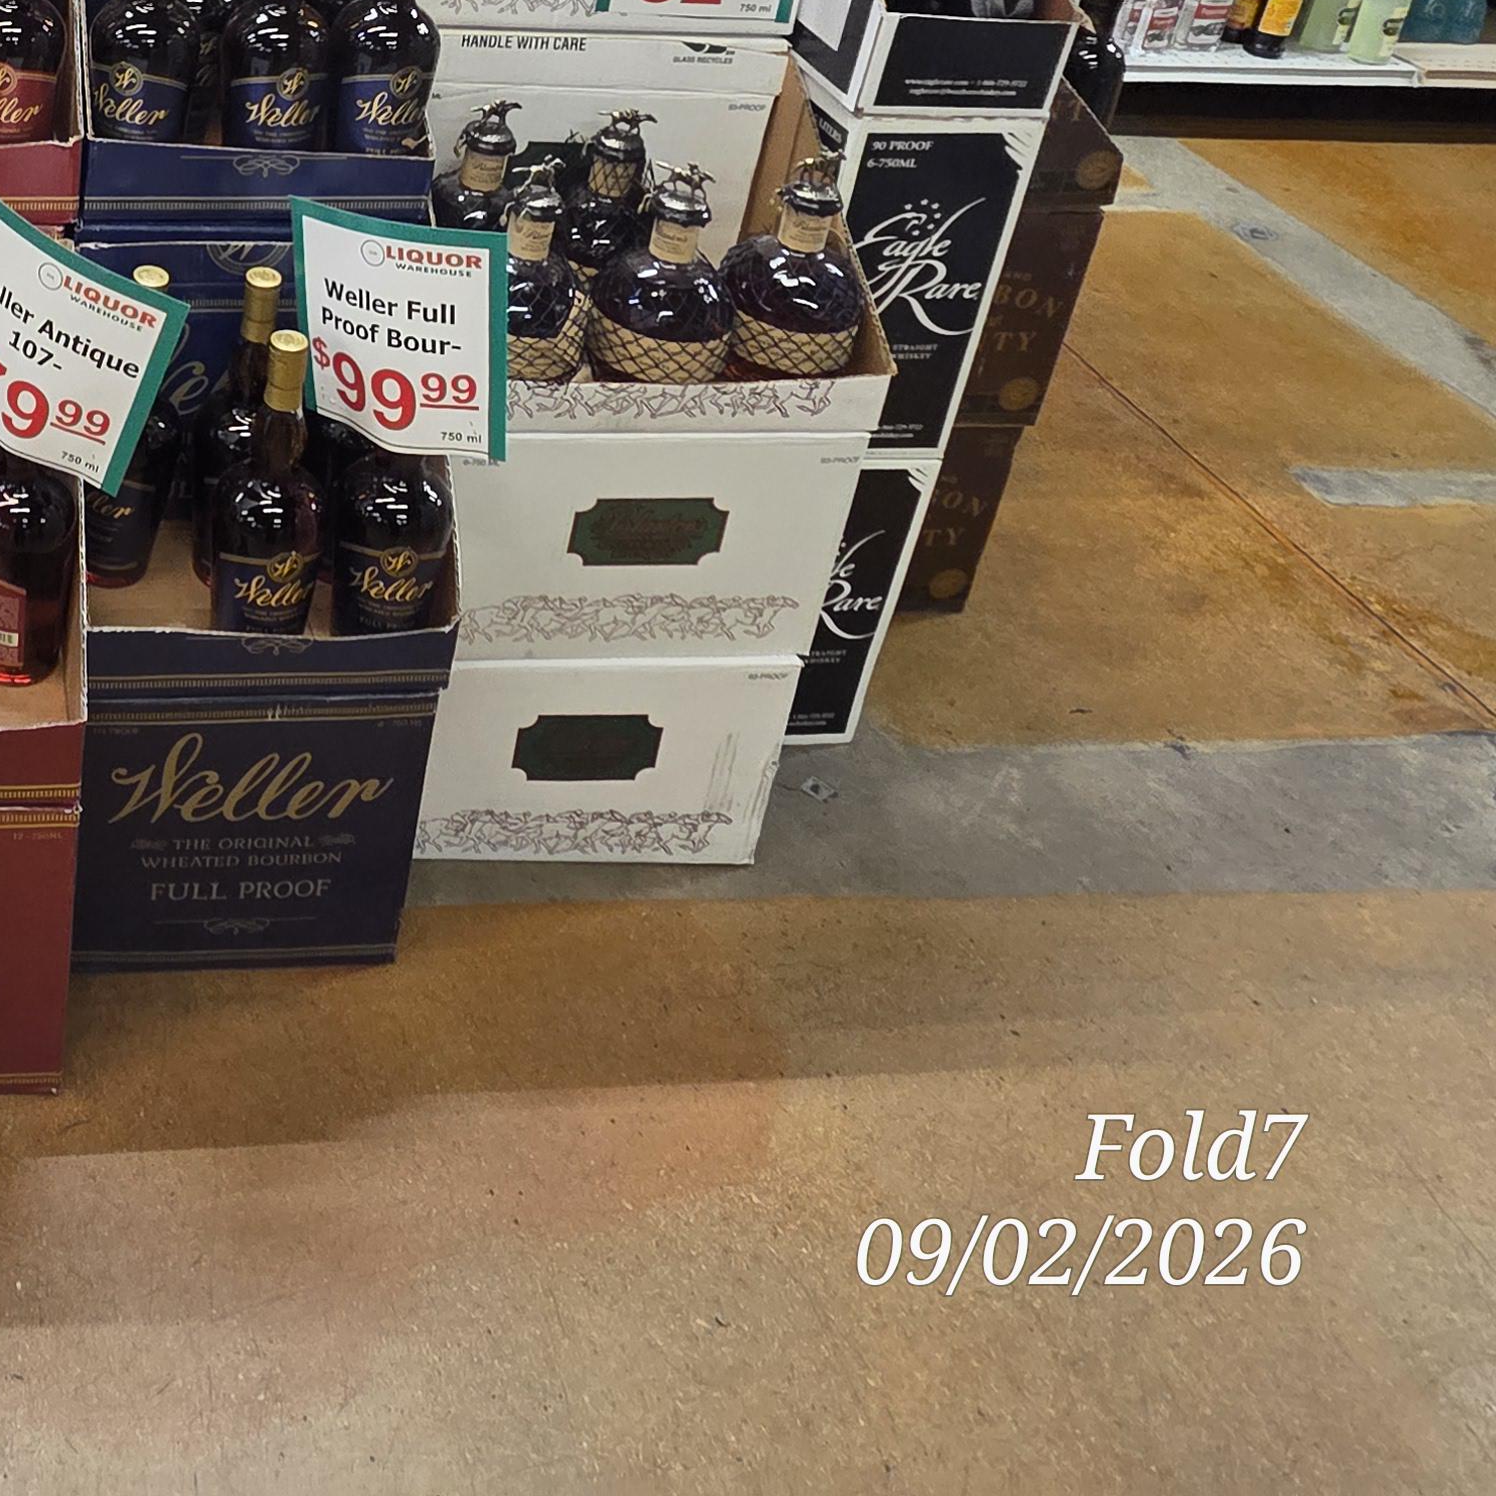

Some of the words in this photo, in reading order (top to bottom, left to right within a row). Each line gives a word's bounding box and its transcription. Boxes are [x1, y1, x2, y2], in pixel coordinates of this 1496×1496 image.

[461, 35, 512, 49] HANDLE
[516, 36, 551, 50] WITH
[553, 36, 587, 51] CARE
[871, 141, 887, 151] 90
[889, 141, 934, 151] PROOF
[385, 245, 482, 269] LIQUOR
[395, 263, 472, 278] WAREHOUSE
[62, 275, 158, 328] LIQUOR
[70, 294, 144, 332] WAREHOUSE
[324, 278, 398, 316] Weller
[407, 300, 456, 325] Full
[322, 306, 380, 343] Proof
[387, 328, 462, 355] Bour-
[8, 330, 62, 372] 107-
[38, 319, 140, 379] Antique
[441, 432, 463, 442] 750
[466, 432, 482, 444] ml
[61, 450, 82, 466] 750
[84, 462, 100, 473] ml
[108, 732, 395, 825] Weller
[171, 838, 211, 851] THE
[218, 835, 316, 850] ORIGINAL
[140, 855, 241, 870] WHEATED
[247, 851, 343, 867] BOURBON
[150, 882, 228, 902] FULL
[238, 878, 332, 900] PROOF
